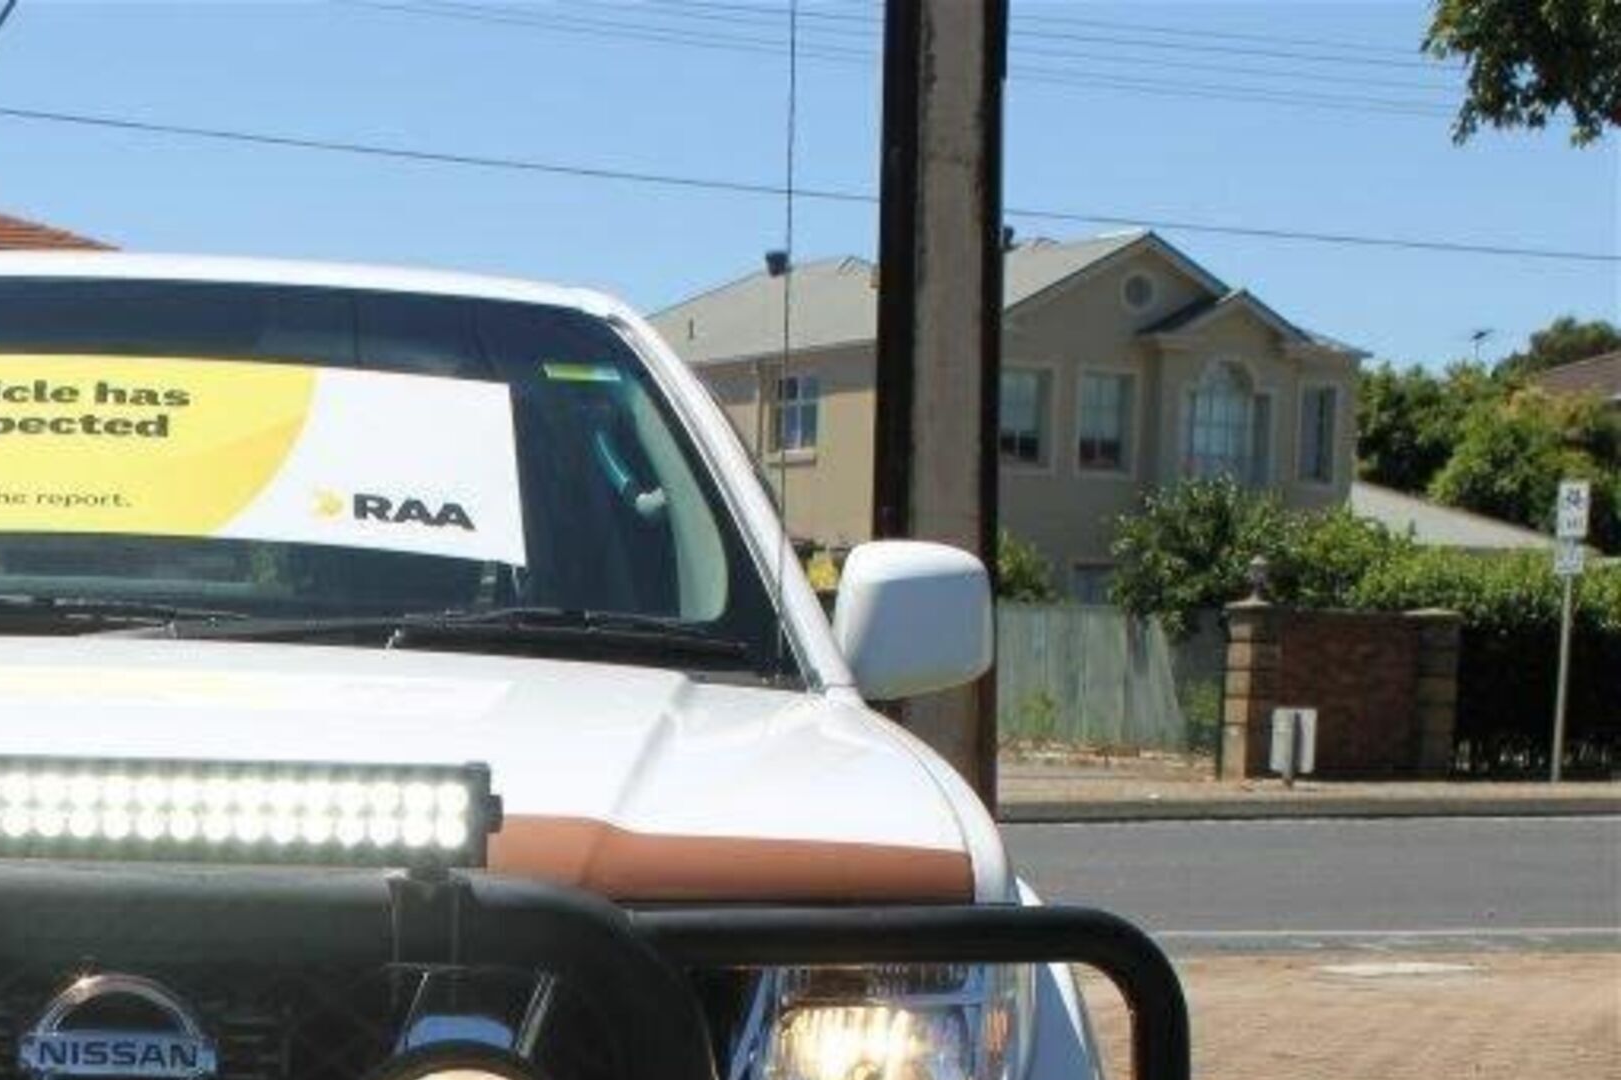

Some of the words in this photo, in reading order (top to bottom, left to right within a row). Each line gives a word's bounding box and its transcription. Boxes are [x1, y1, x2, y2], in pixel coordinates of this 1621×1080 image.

[94, 381, 191, 407] has
[36, 491, 132, 509] report.
[353, 493, 476, 531] RAA
[38, 1040, 198, 1069] NISSAN
